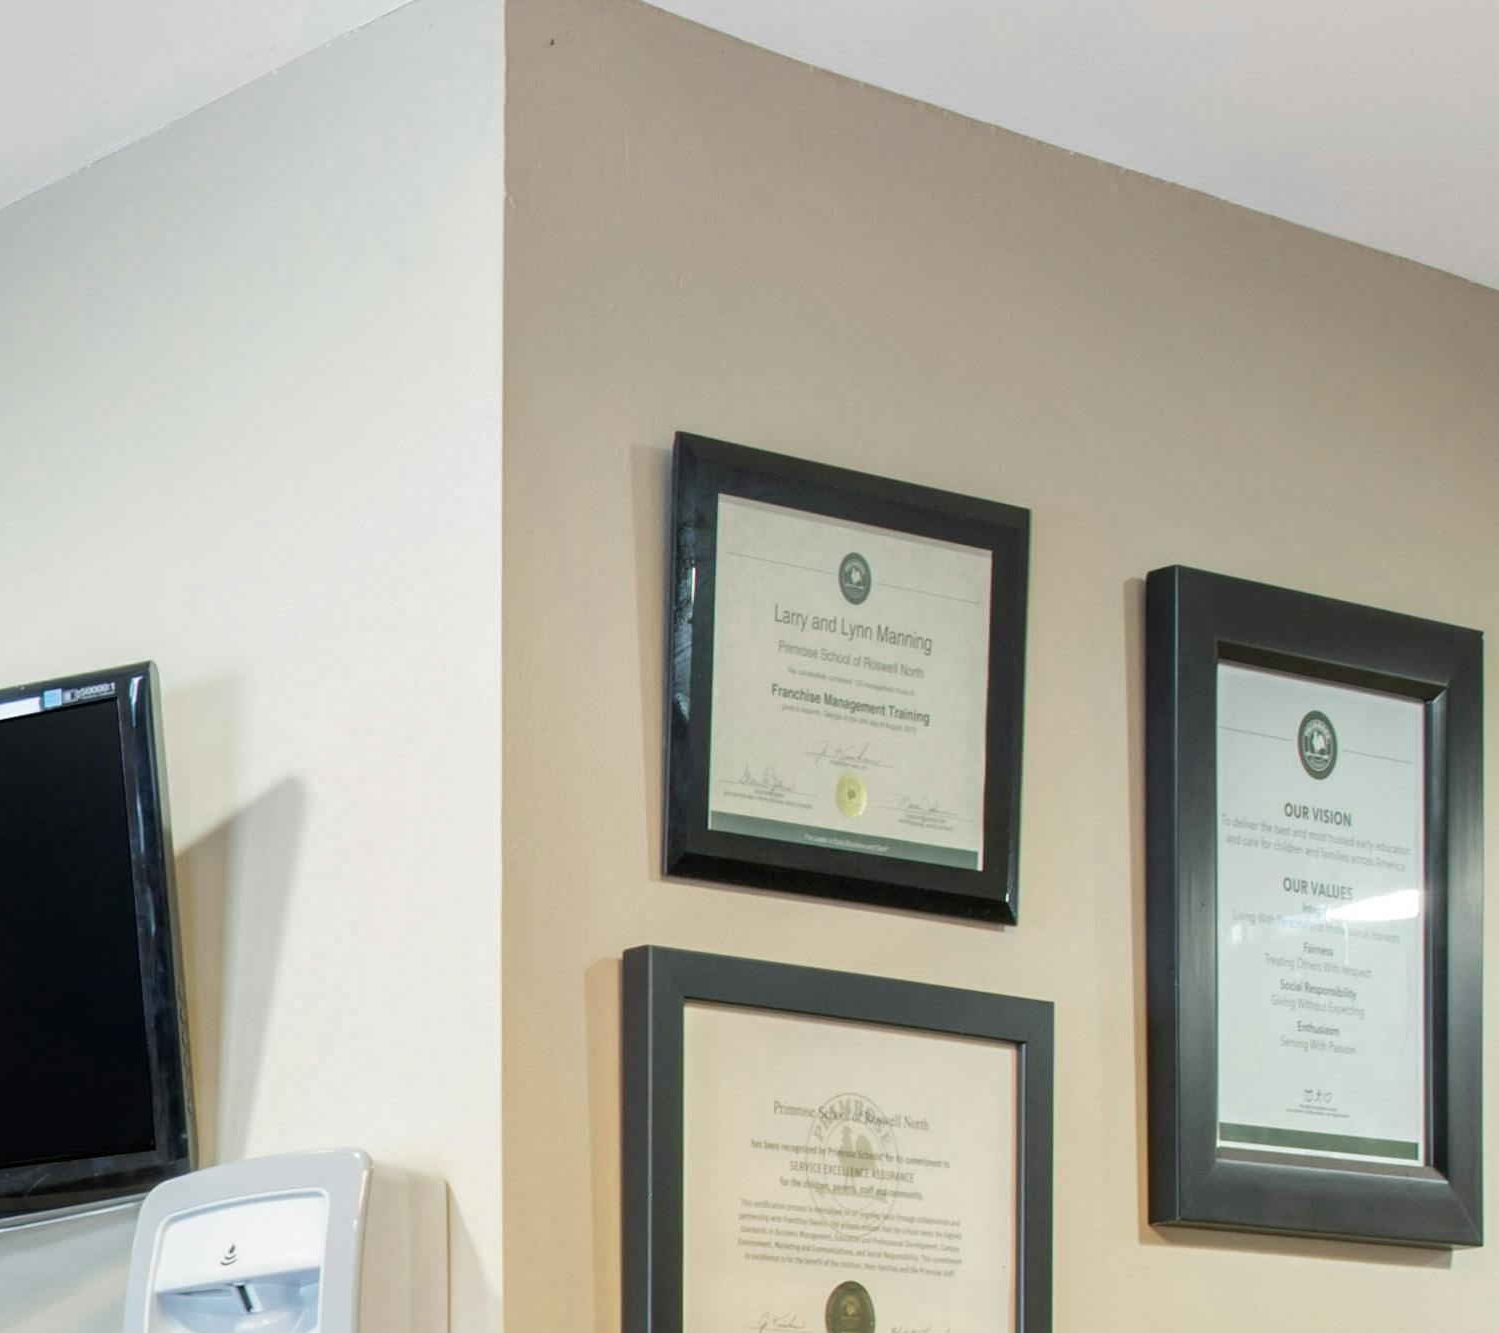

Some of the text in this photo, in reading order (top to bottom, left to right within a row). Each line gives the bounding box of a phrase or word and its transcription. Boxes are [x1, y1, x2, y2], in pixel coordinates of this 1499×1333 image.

[774, 604, 933, 656] Larry and Lynn Manning
[778, 640, 819, 660] Primrose
[821, 648, 851, 666] School
[863, 656, 898, 675] Roswell
[901, 664, 925, 679] North
[772, 683, 821, 704] Franchise
[823, 692, 886, 714] Management
[888, 704, 931, 727] Training
[1284, 802, 1352, 827] OUR VISION
[1283, 877, 1354, 901] OUR VALUES
[1303, 942, 1334, 957] Fairness
[1280, 978, 1357, 1001] Social Responsibility
[773, 1100, 816, 1118] Primrose
[903, 1115, 930, 1132] North
[790, 1160, 915, 1184] SERVICE EXCELLENCE ASSURANCE
